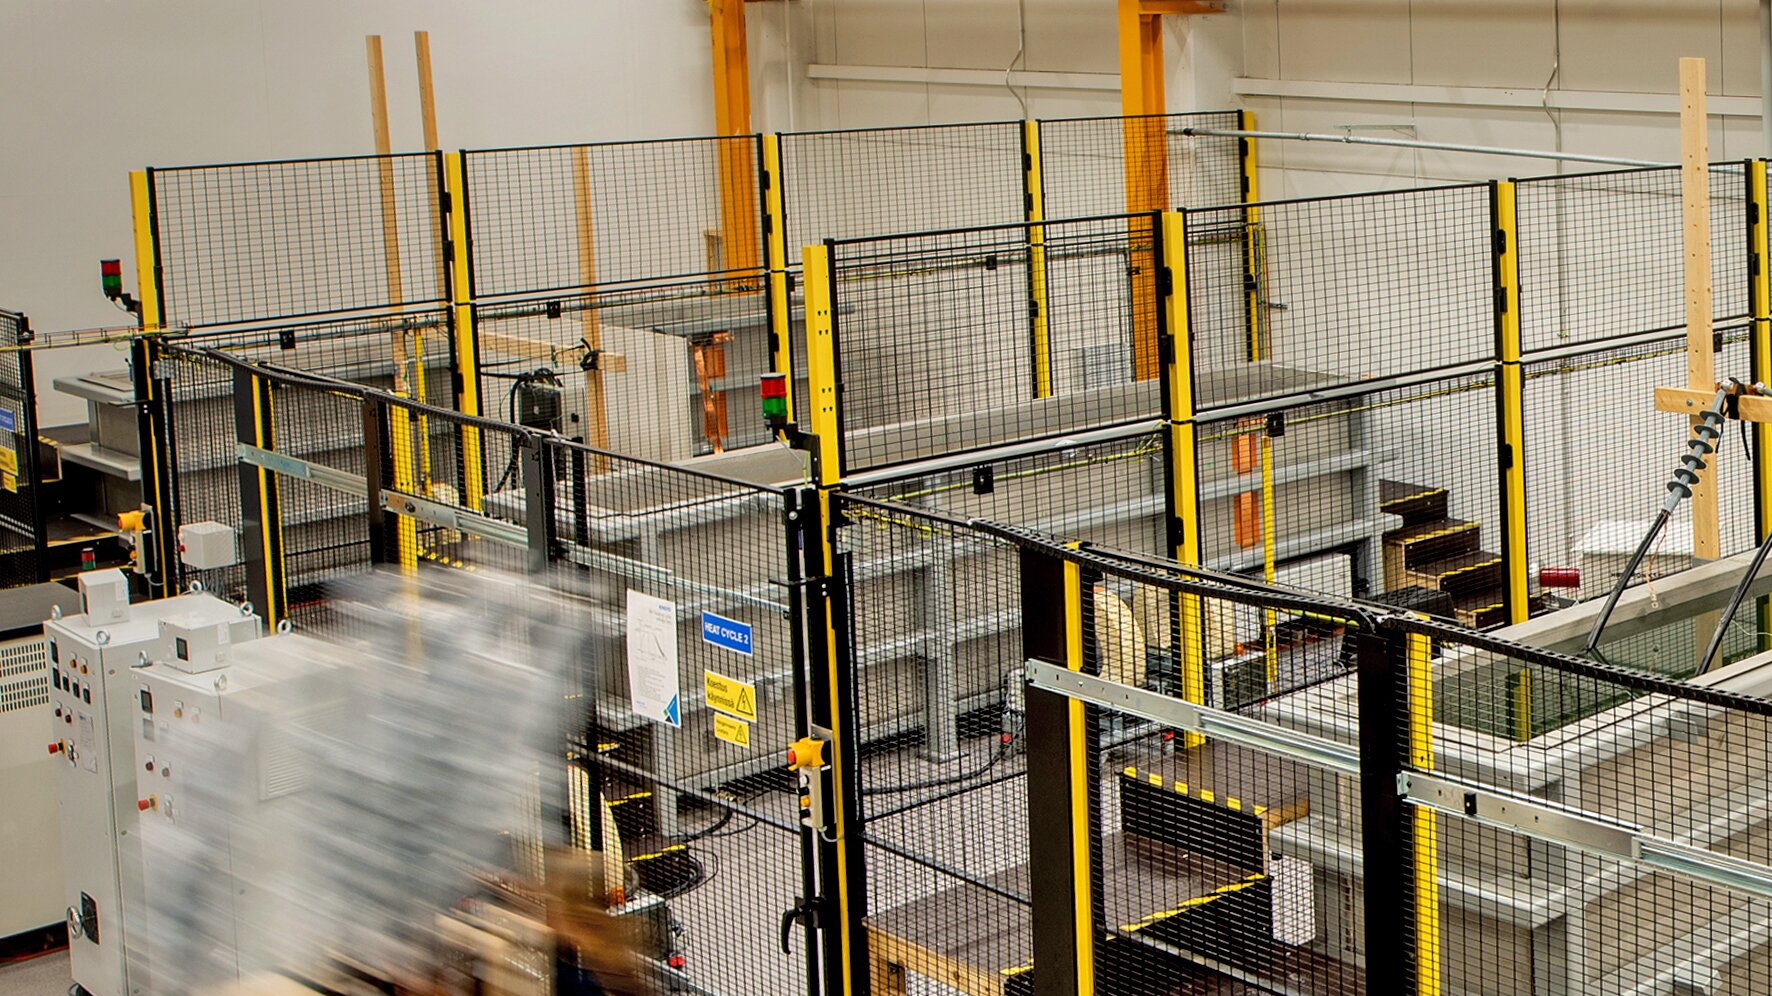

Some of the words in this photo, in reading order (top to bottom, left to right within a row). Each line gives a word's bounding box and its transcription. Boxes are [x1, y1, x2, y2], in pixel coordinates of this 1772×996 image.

[704, 621, 720, 635] HEAT
[721, 627, 743, 643] CYCLE
[743, 634, 749, 645] 2
